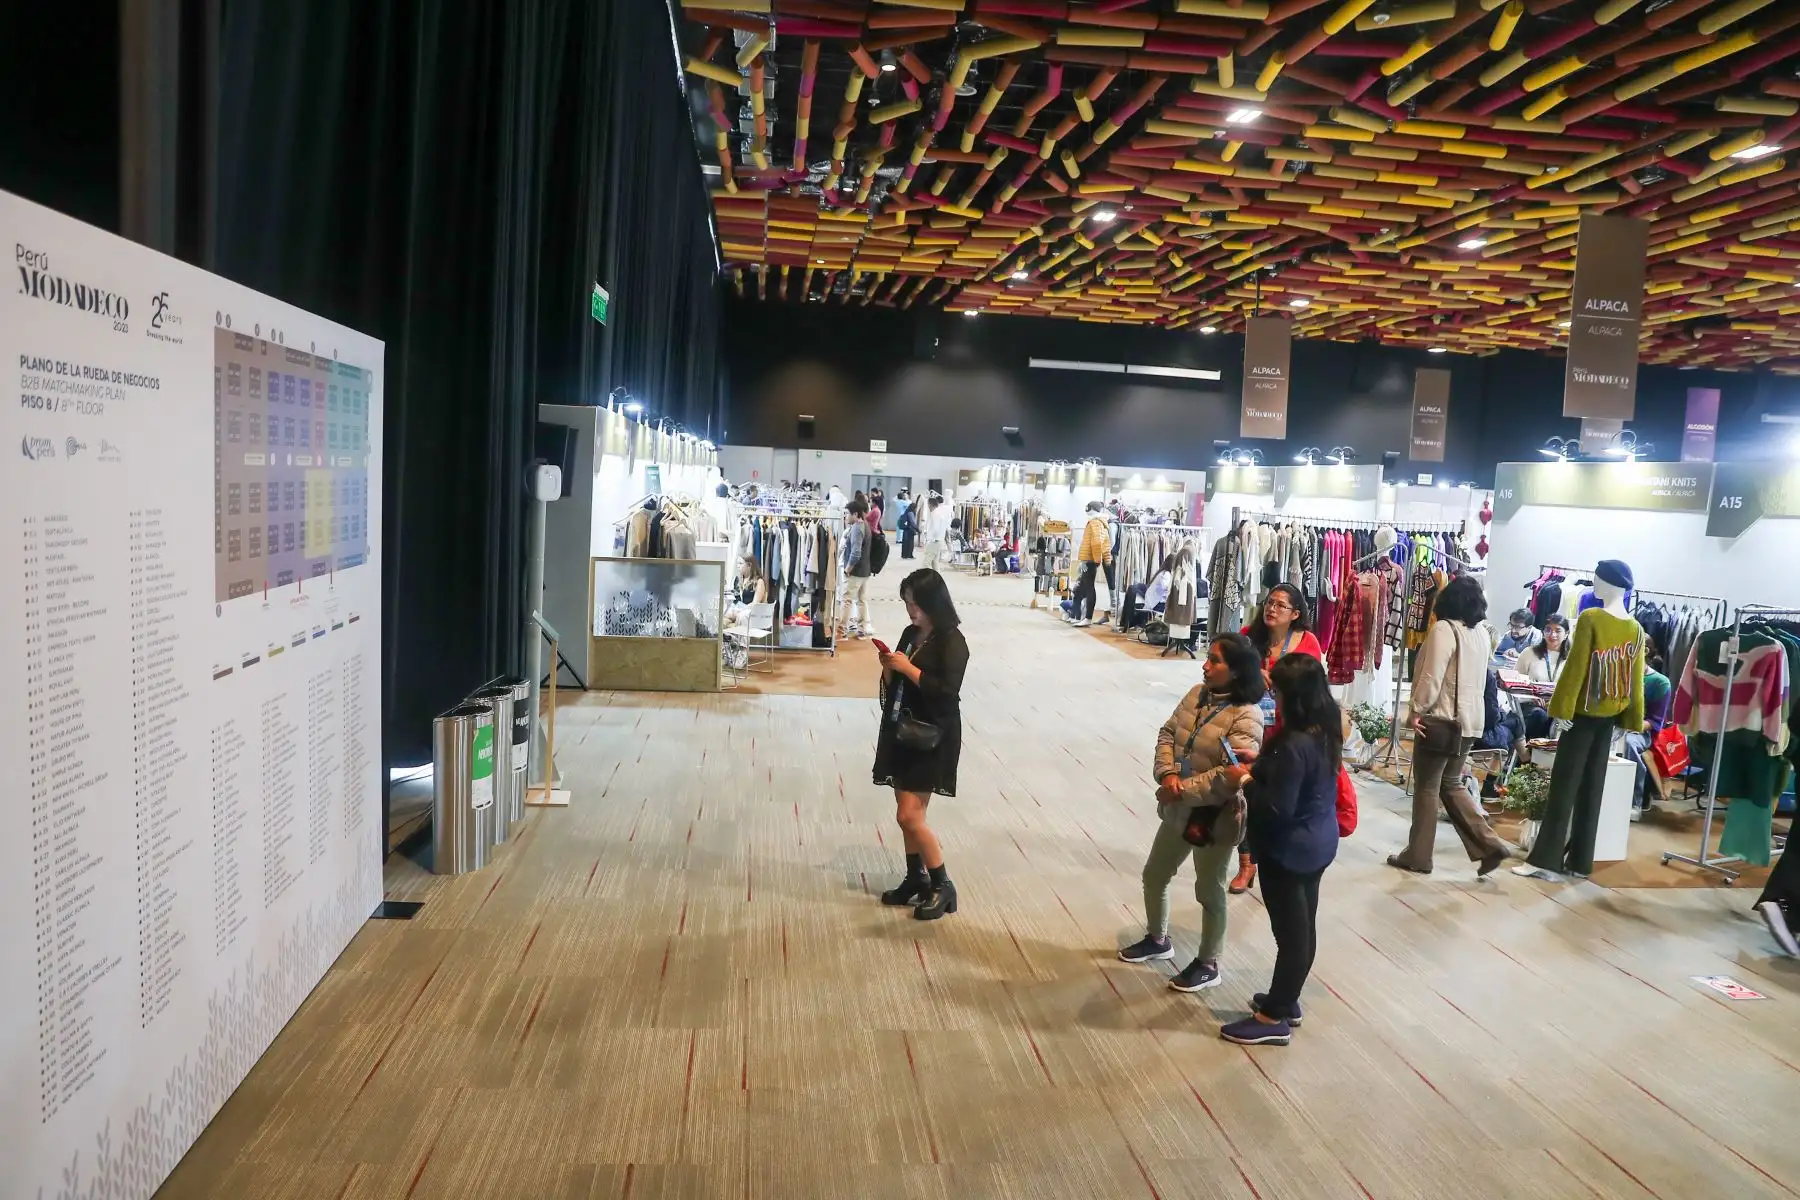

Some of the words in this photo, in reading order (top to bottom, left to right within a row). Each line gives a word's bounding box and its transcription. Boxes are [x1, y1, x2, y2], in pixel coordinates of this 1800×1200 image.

[16, 243, 48, 270] Perú
[1585, 298, 1629, 313] ALPACA
[113, 320, 129, 334] 2023
[1588, 325, 1623, 336] ALPACA
[20, 354, 53, 373] PLANO
[56, 362, 68, 375] DE
[70, 364, 81, 378] LA
[83, 366, 109, 382] RUEDA
[111, 371, 122, 384] DE
[123, 373, 160, 390] NEGOCIOS
[1252, 367, 1281, 375] ALPACA
[21, 374, 39, 390] B2B
[42, 378, 104, 398] MATCHMAKING
[105, 387, 126, 401] PLAN
[21, 394, 44, 410] PISO
[46, 398, 52, 411] 8
[76, 400, 104, 415] FLOOR
[1671, 477, 1697, 487] KNITS
[1499, 489, 1513, 499] A16
[1719, 496, 1743, 509] A15
